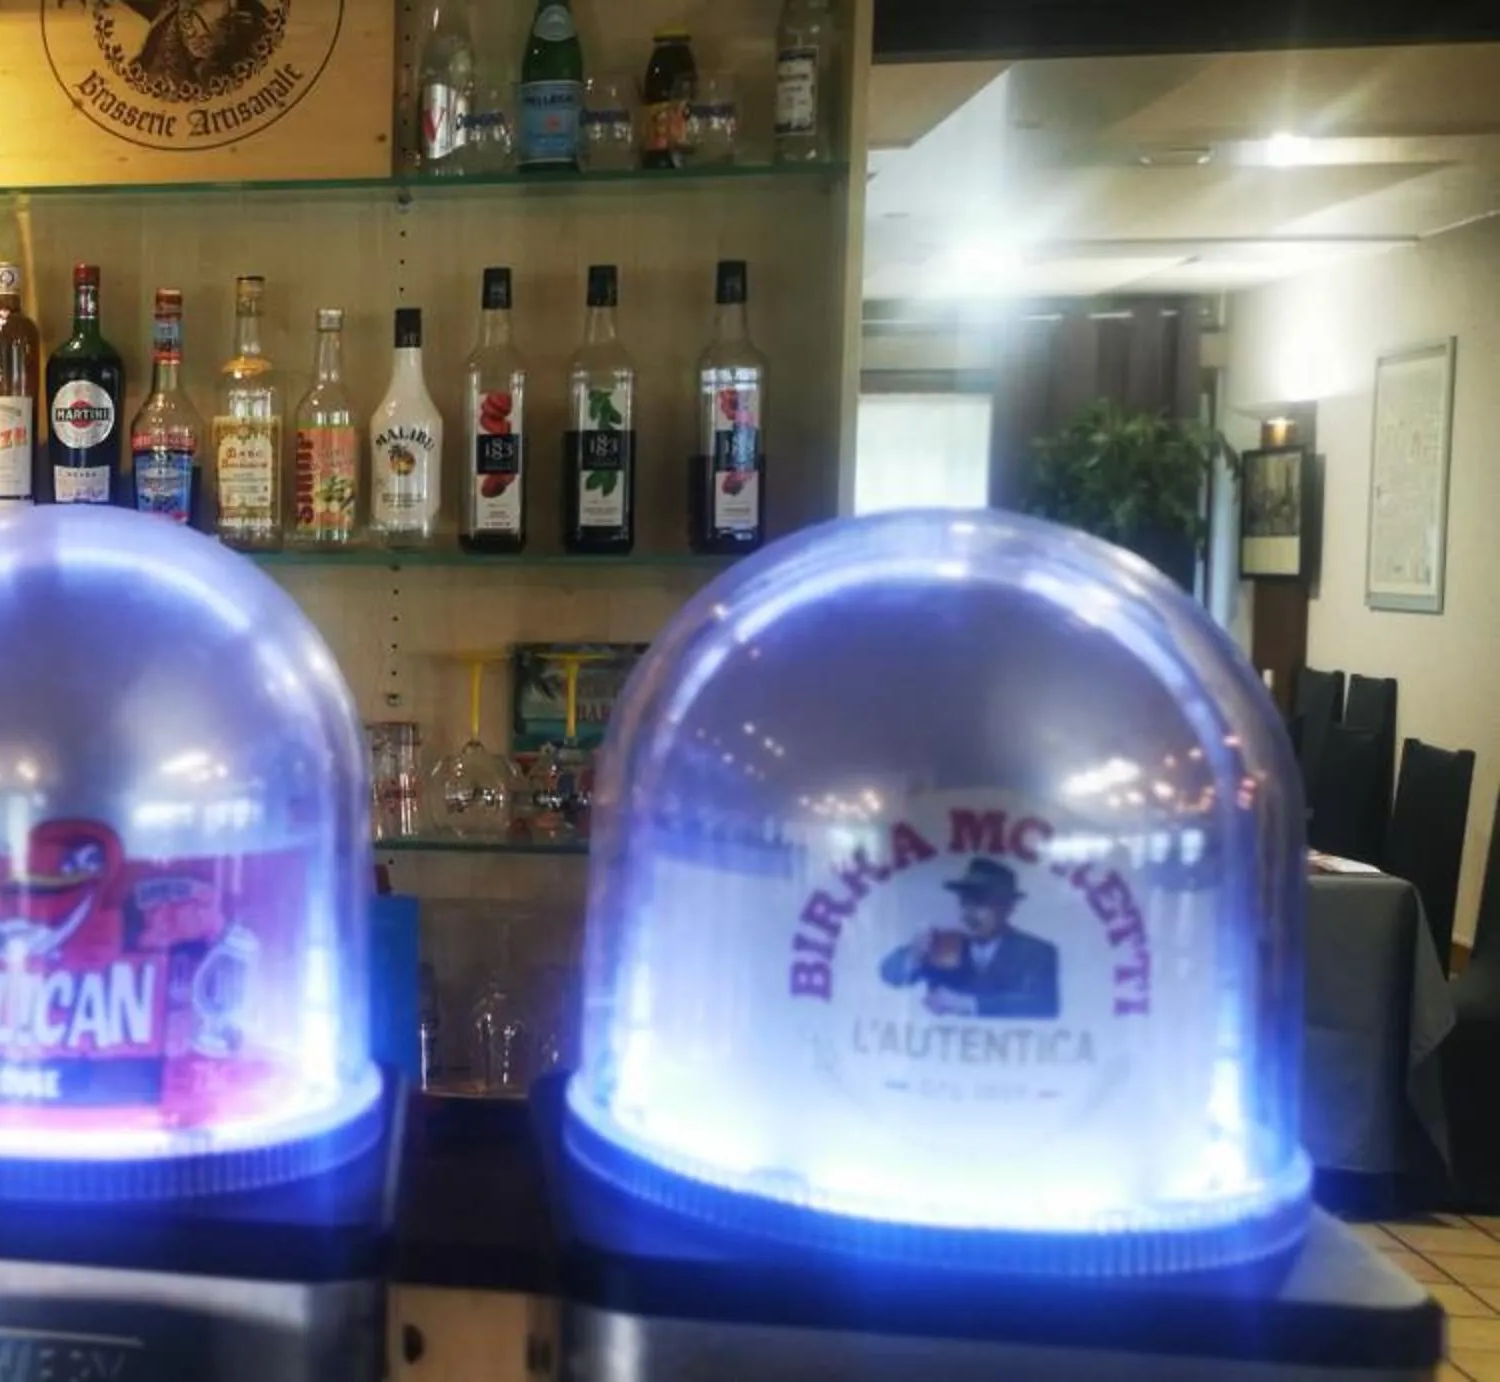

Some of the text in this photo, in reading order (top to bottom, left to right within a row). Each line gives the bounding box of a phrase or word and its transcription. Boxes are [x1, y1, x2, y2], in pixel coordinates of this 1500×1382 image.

[73, 62, 306, 138] Brasserie Artisanale
[56, 408, 109, 422] MARTINI
[375, 427, 436, 451] MALIBU
[853, 1016, 1097, 1067] L'AUTENTICA
